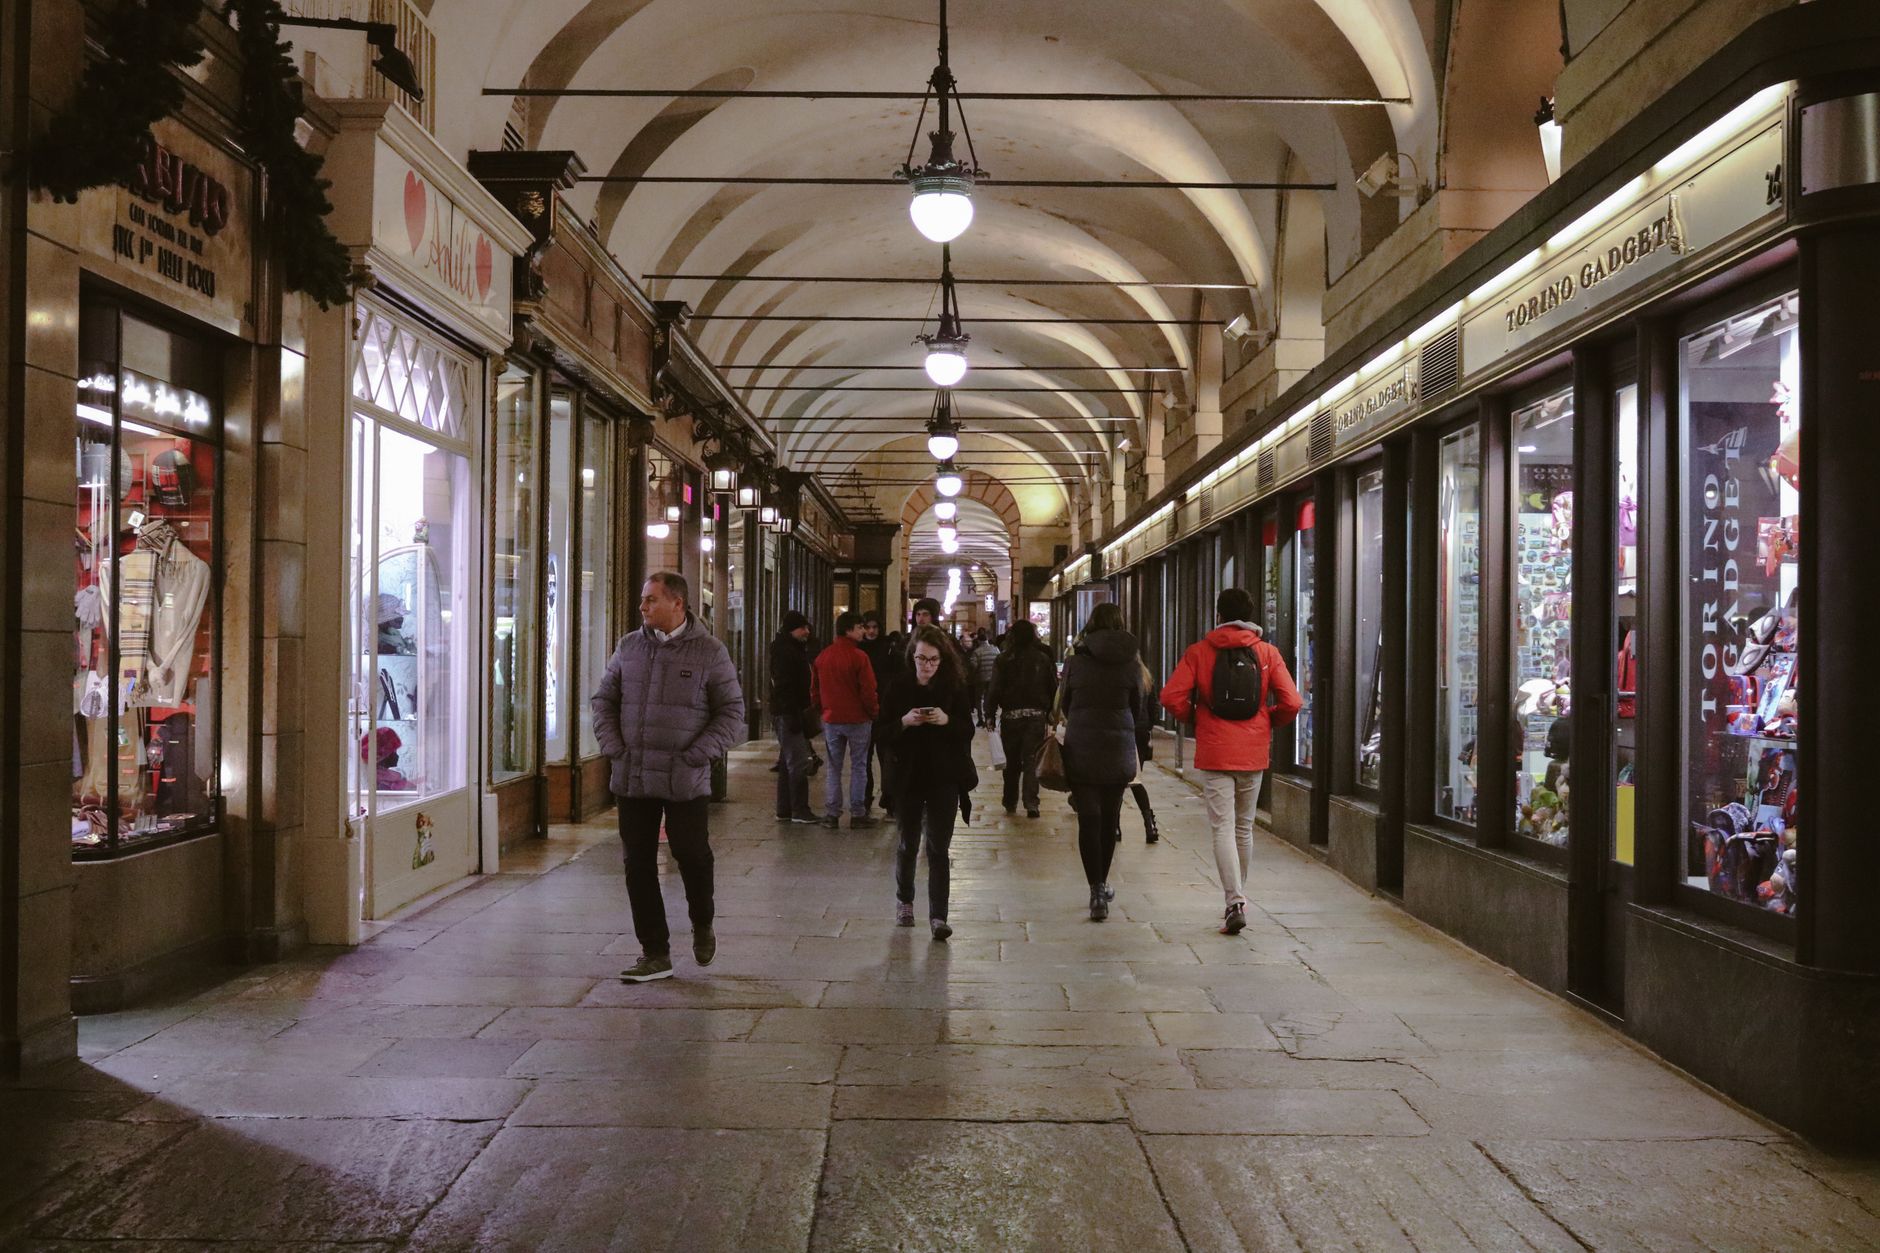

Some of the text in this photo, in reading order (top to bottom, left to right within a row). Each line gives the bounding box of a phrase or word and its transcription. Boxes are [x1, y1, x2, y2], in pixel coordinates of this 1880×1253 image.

[1506, 216, 1667, 332] TORINO GADGET
[1334, 403, 1364, 431] ORINO
[1701, 473, 1720, 723] TORINO
[1722, 437, 1741, 677] GADGET
